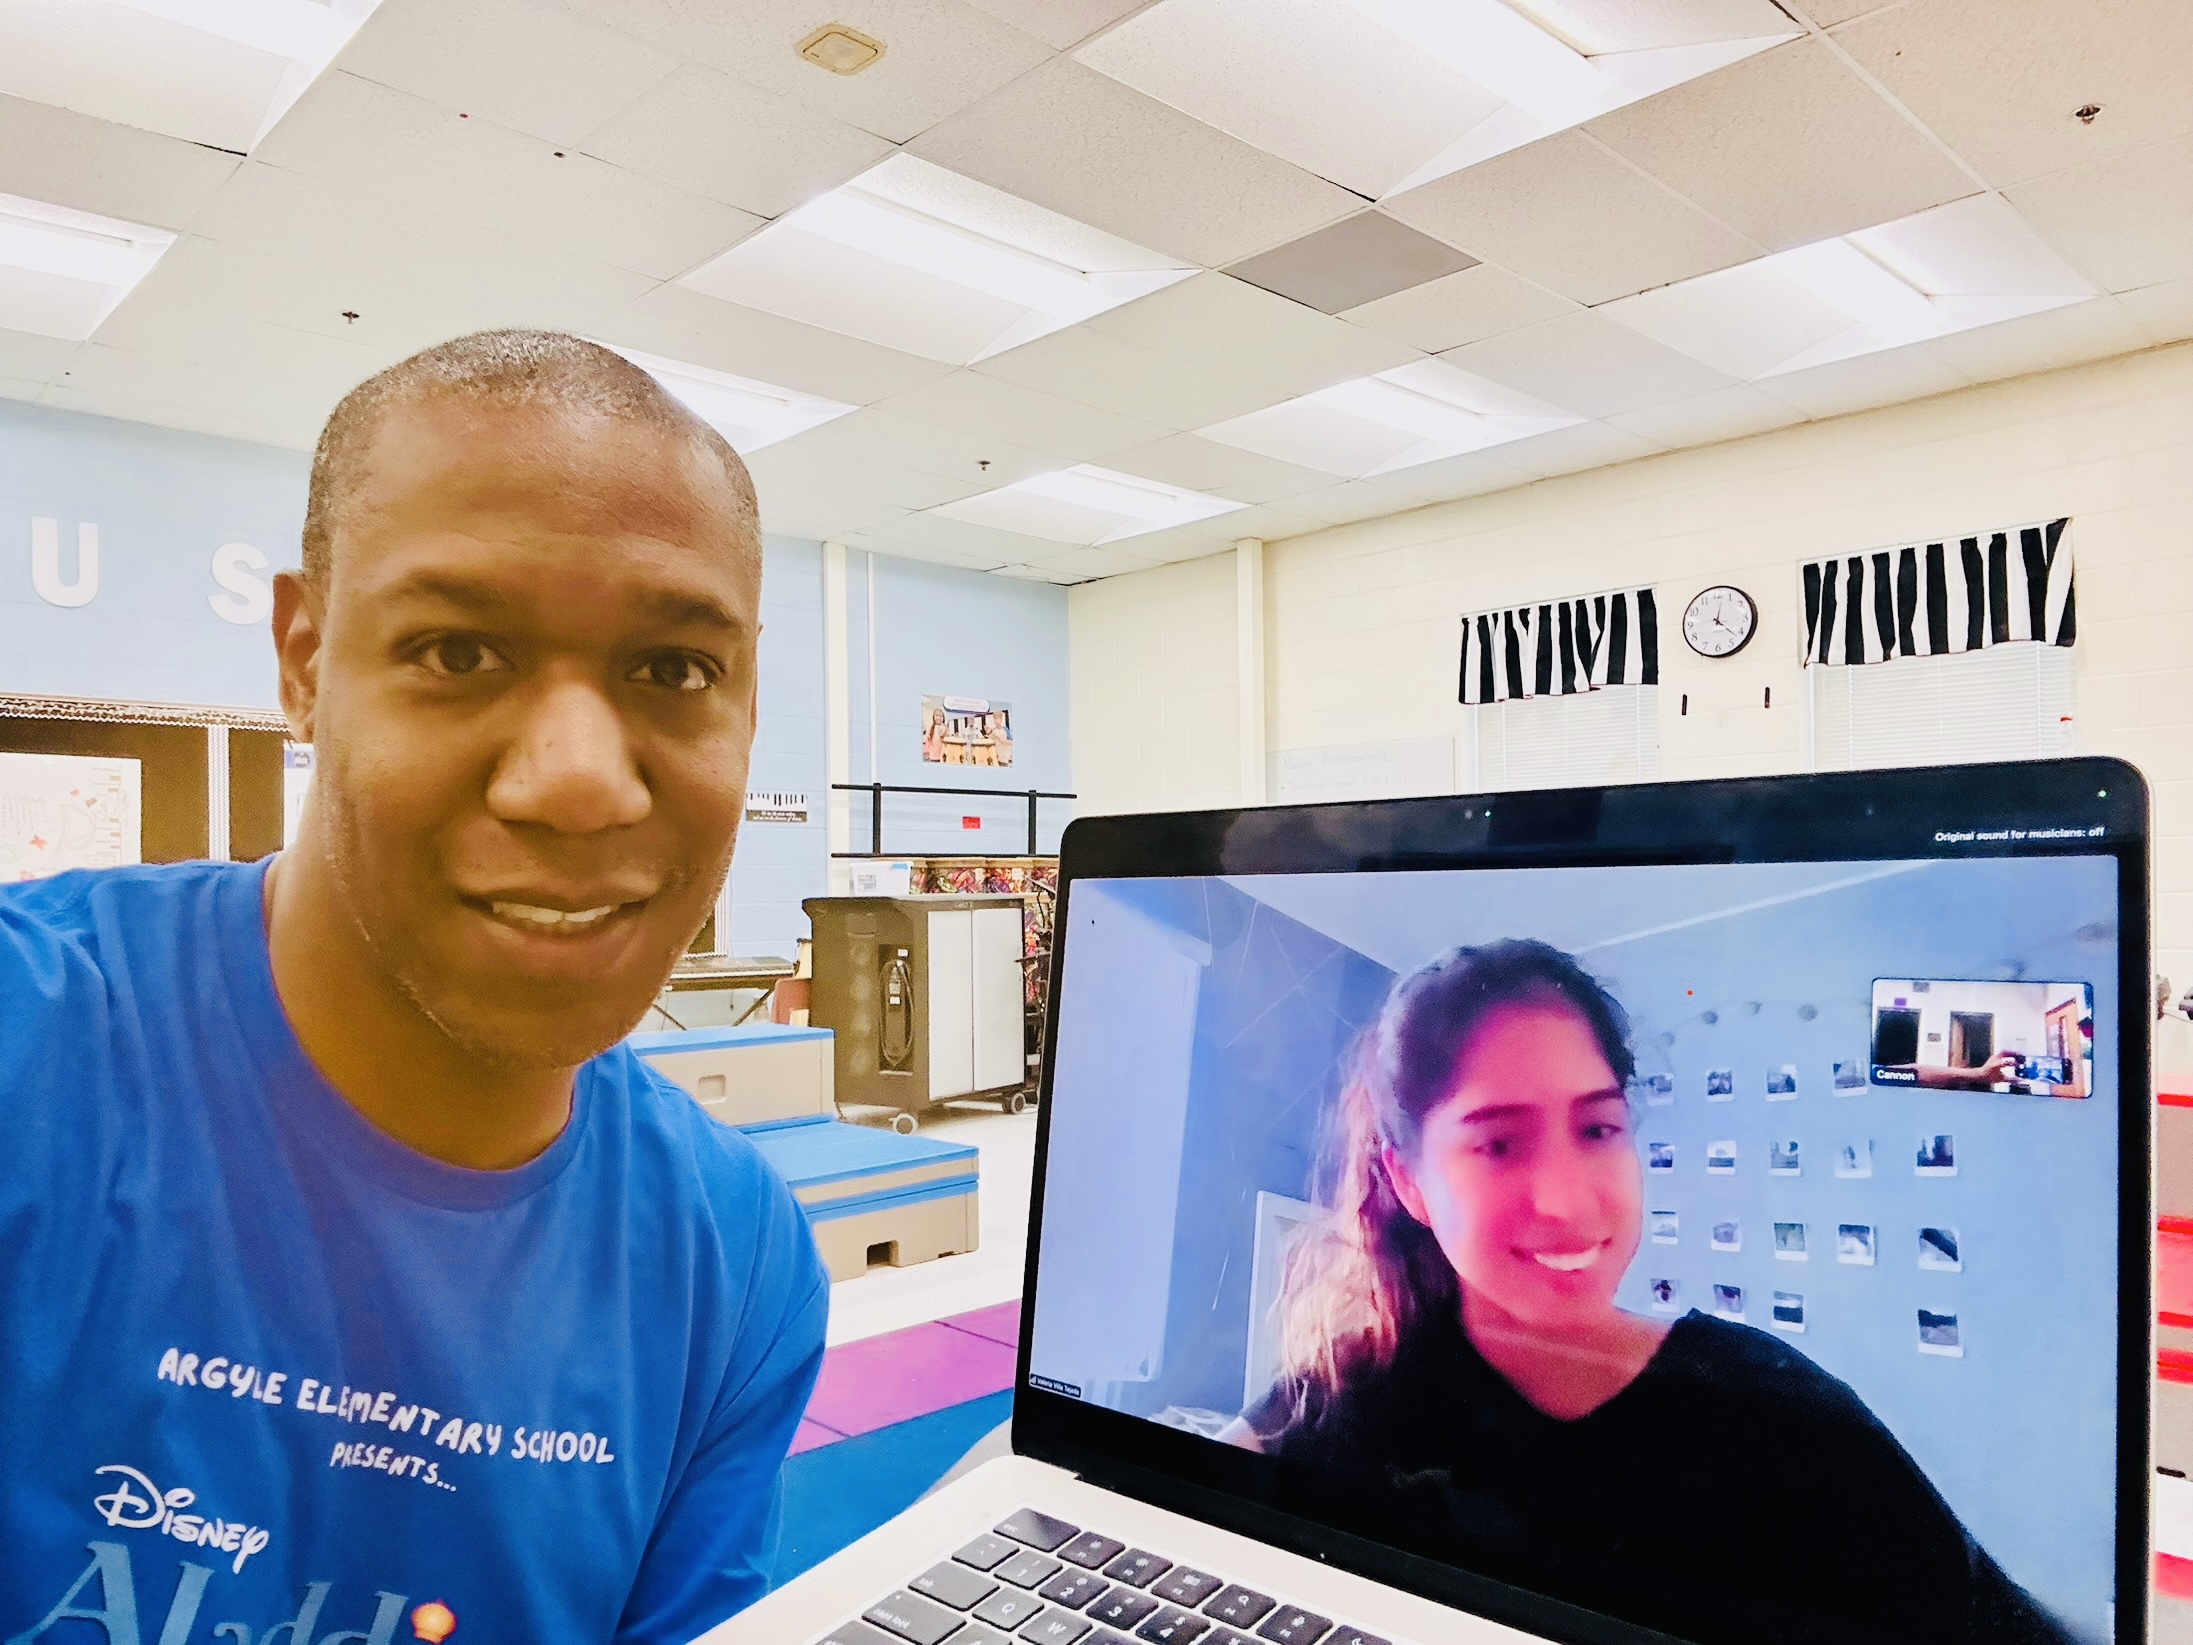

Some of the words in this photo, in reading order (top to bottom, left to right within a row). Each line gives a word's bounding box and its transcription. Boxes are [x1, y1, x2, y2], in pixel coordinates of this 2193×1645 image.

[1935, 831, 1974, 843] Original
[1976, 830, 2009, 841] sound
[2011, 829, 2026, 840] for
[2028, 828, 2086, 839] musicians:
[2088, 825, 2106, 837] off
[1876, 1069, 1915, 1081] Cannon
[157, 1347, 286, 1405] ARGYLE
[296, 1378, 501, 1455] ELEMENTARY
[511, 1426, 614, 1465] SCHOOL
[1001, 1602, 1016, 1615] Q
[1107, 1605, 1123, 1618] 3
[1047, 1621, 1067, 1636] W
[1159, 1627, 1174, 1639] 4
